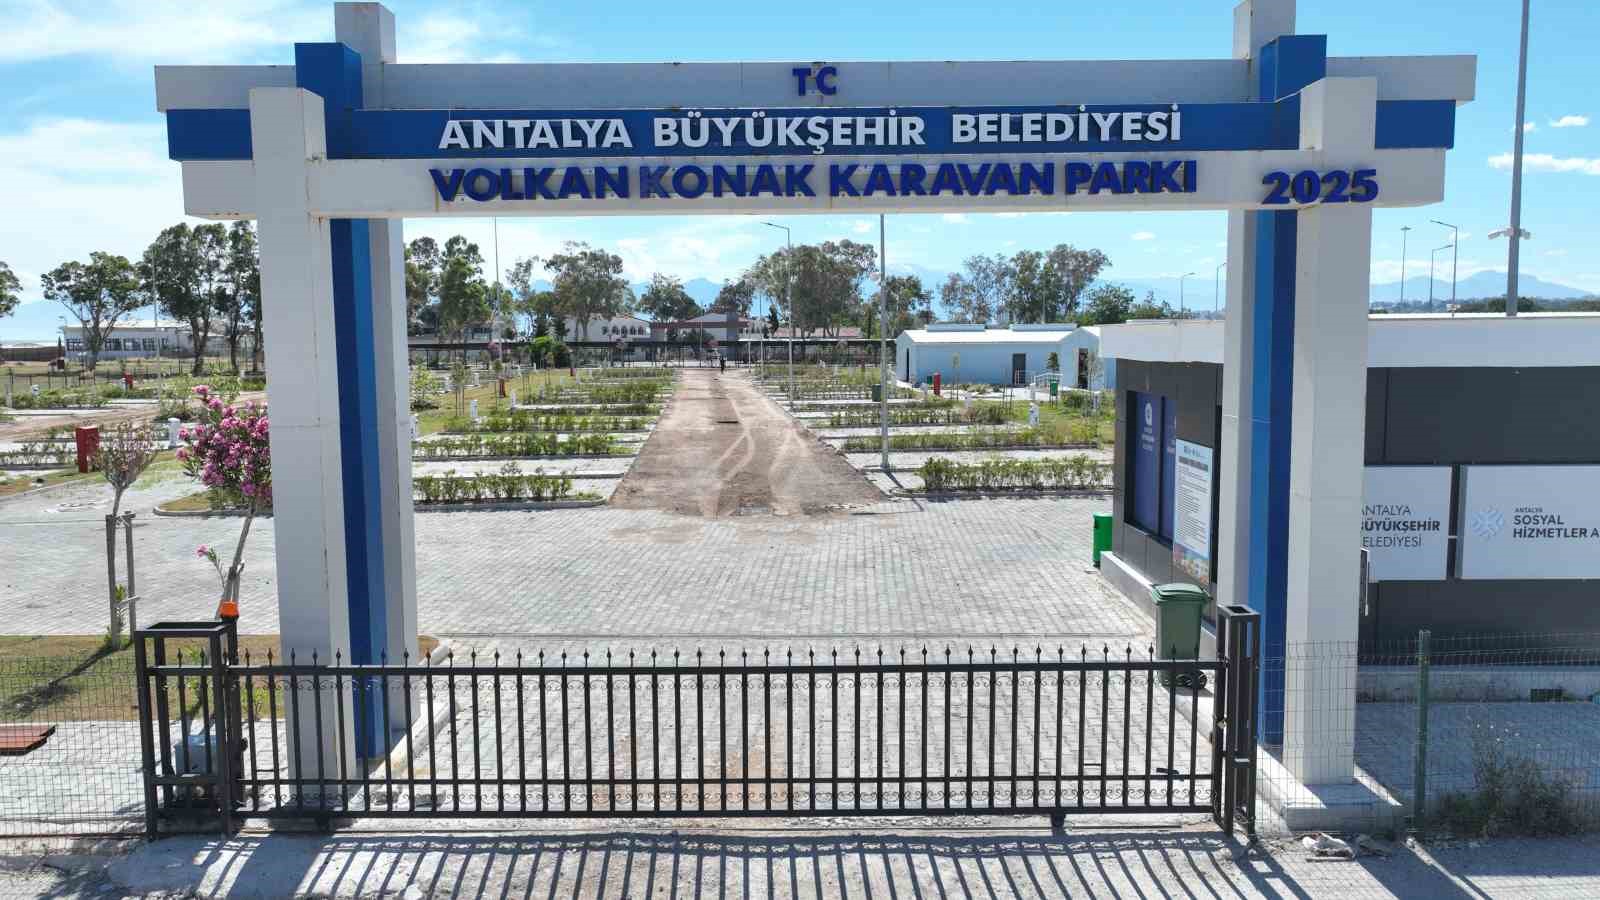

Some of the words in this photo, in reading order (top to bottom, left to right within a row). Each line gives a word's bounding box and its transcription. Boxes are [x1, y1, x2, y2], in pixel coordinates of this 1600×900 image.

[438, 118, 633, 149] ANTALYA
[653, 110, 926, 155] BÜYÜKŞEHİR
[952, 103, 1181, 144] BELEDİYESİ
[428, 166, 630, 202] VOLKAN
[639, 163, 816, 199] KONAK
[829, 162, 1054, 198] KARAVAN
[1064, 160, 1197, 196] PARKI
[1261, 169, 1379, 205] 2025
[1513, 514, 1565, 525] SOSYAL
[1513, 526, 1588, 539] HİZMETLER
